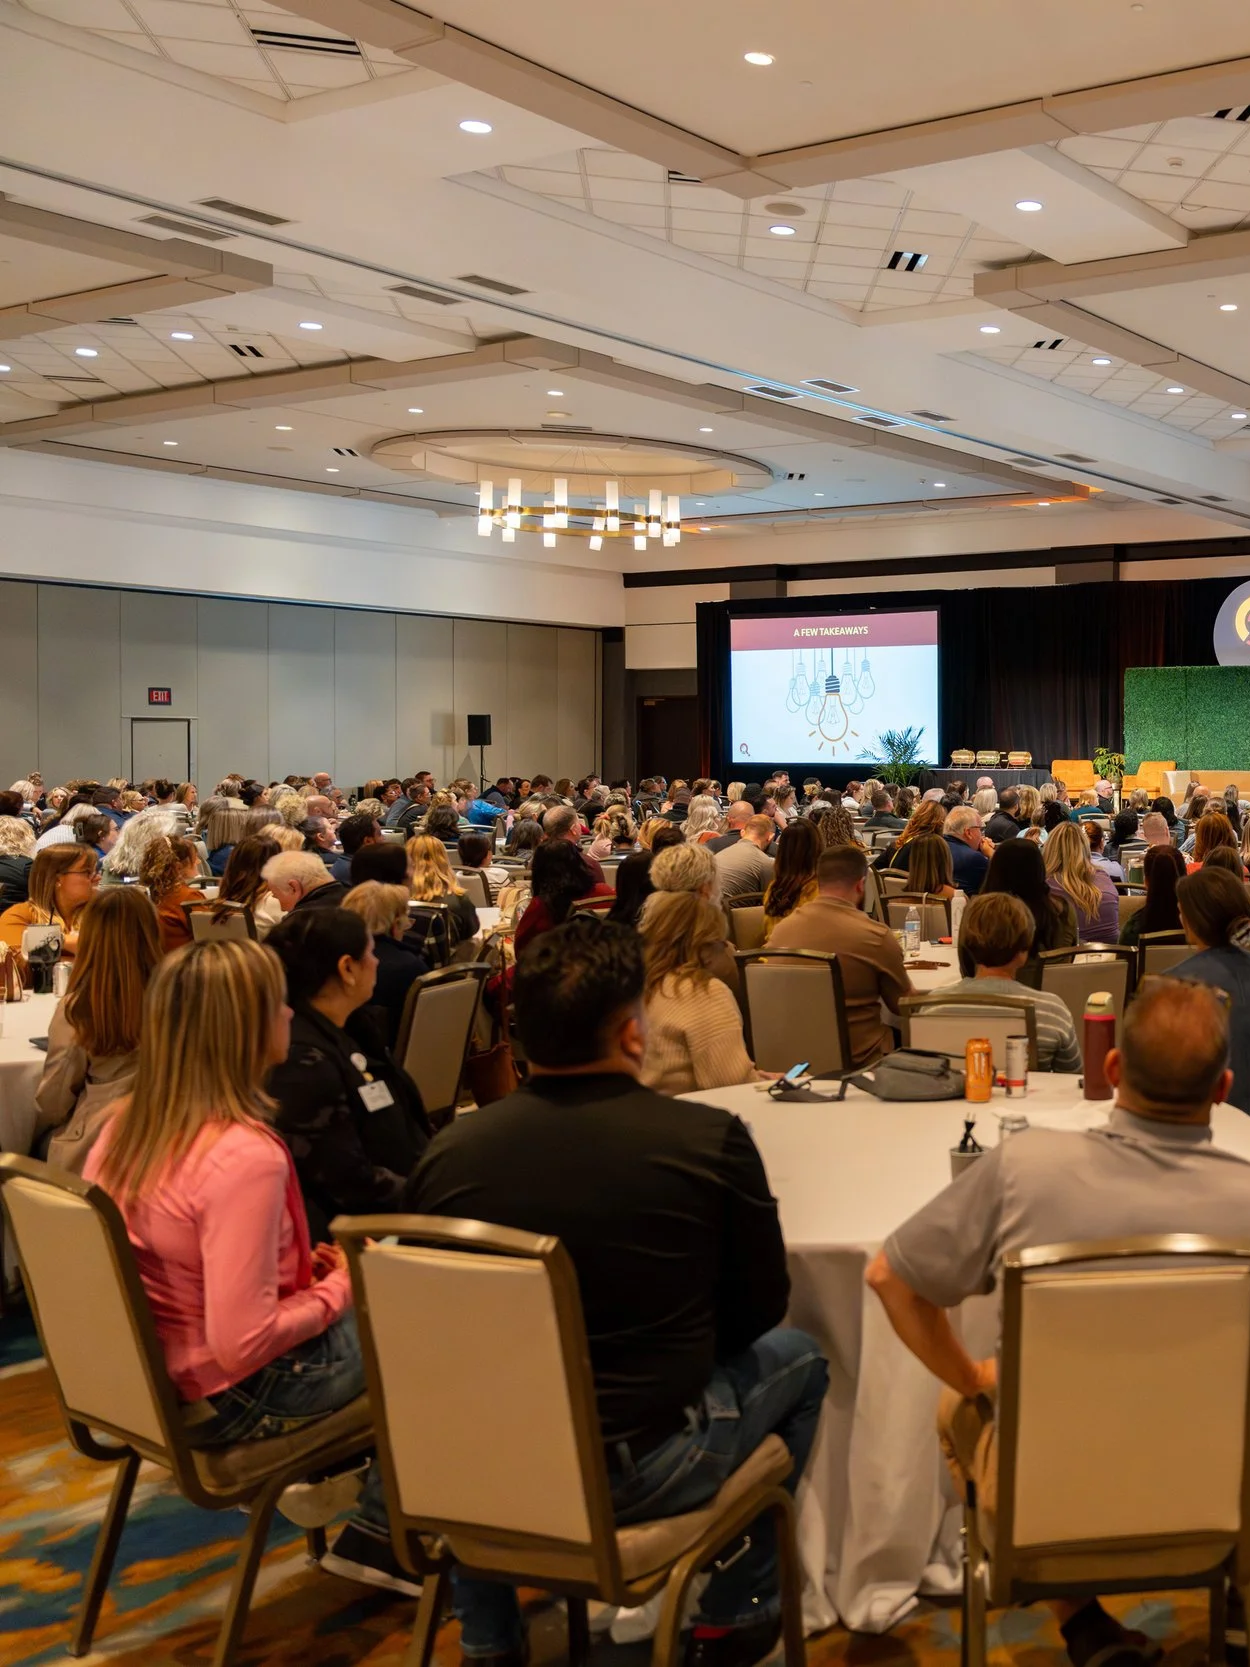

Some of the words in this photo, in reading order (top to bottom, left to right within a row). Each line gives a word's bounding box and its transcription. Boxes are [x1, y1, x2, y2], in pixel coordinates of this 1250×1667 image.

[793, 628, 800, 637] A
[801, 628, 818, 637] FEW
[819, 626, 869, 636] TAKEAWAYS
[153, 690, 168, 701] EXIT
